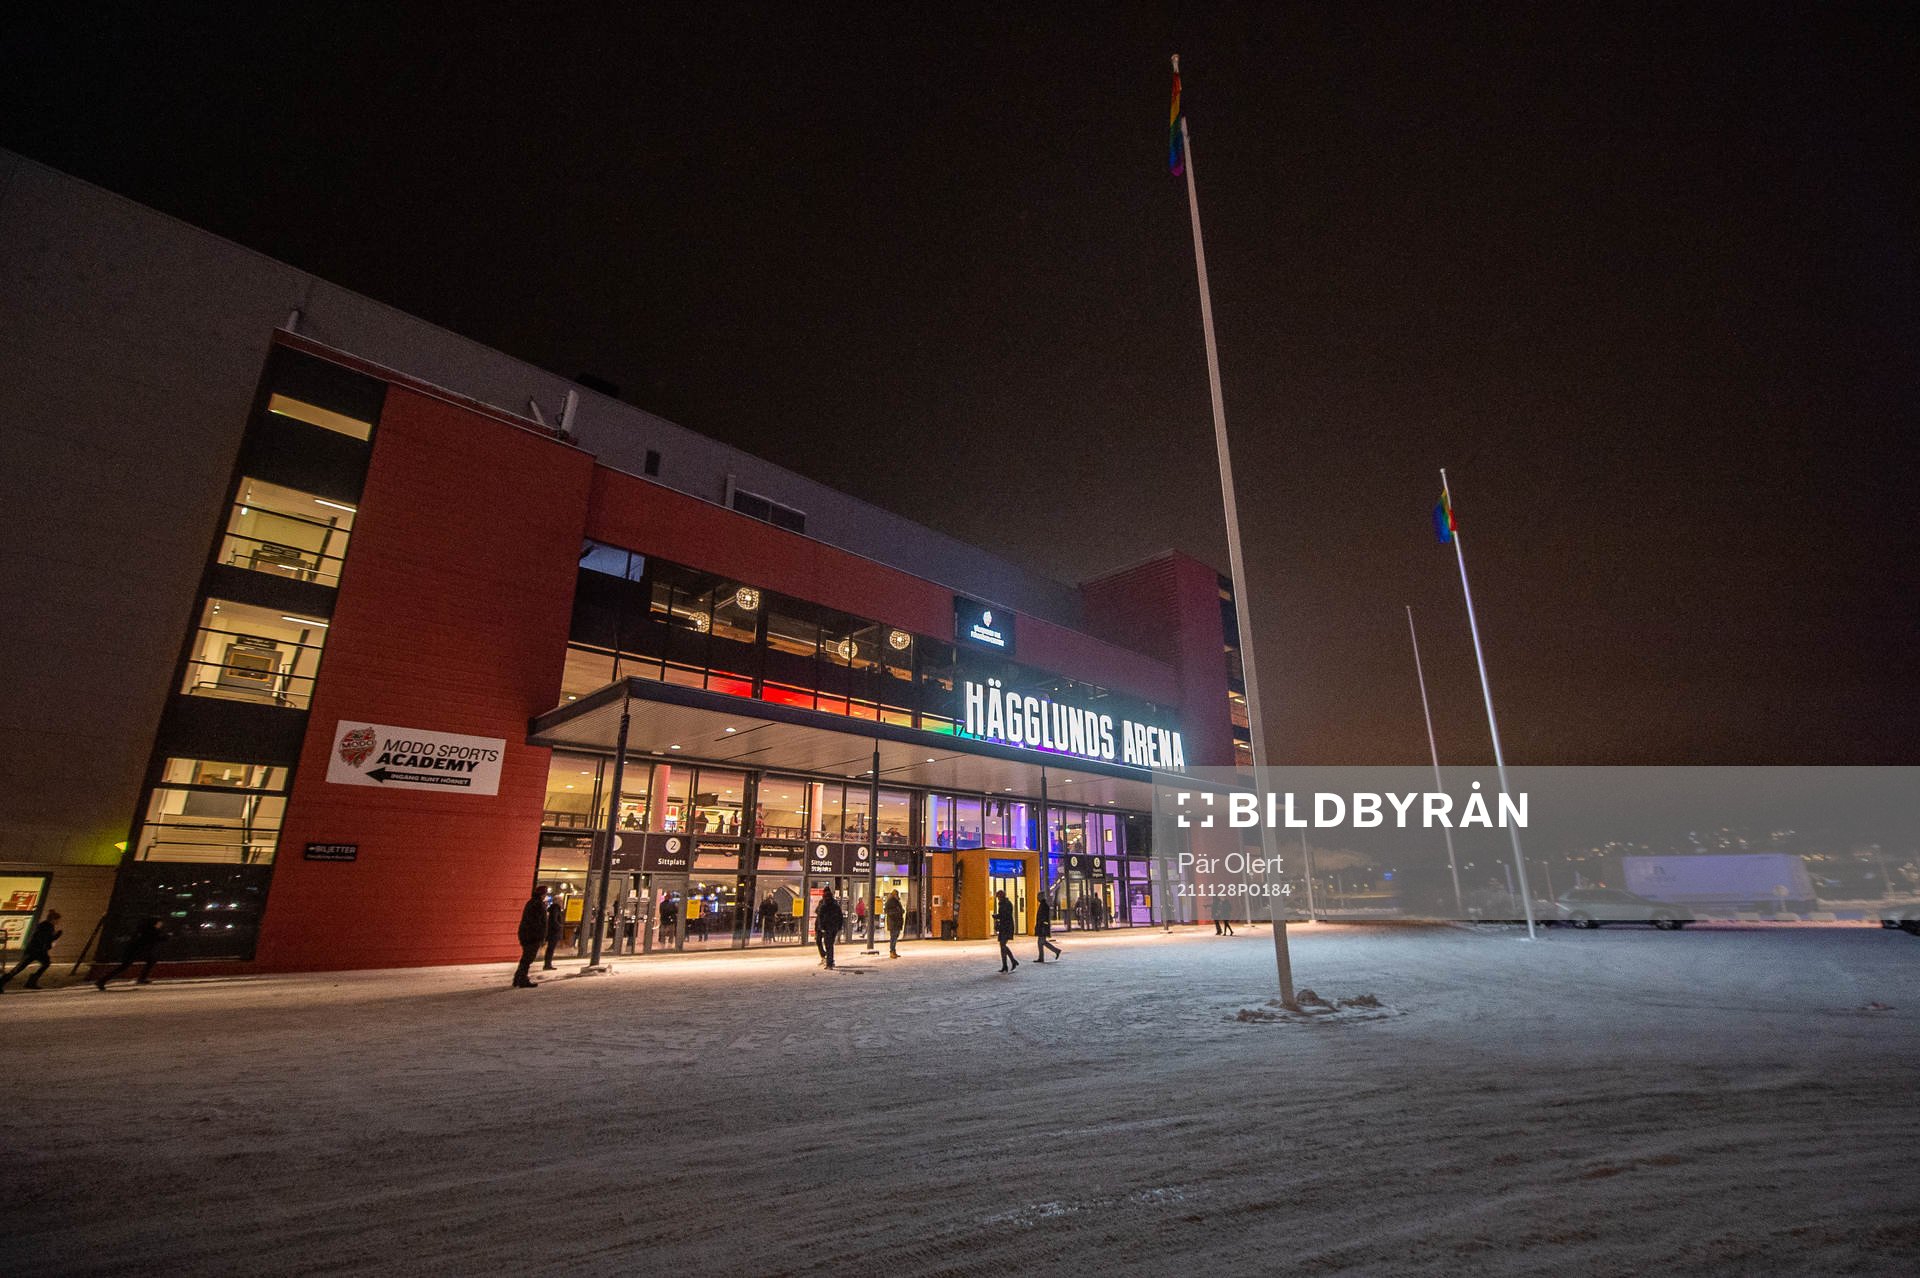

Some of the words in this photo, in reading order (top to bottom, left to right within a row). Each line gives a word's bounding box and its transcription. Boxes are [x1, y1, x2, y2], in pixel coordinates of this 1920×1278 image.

[965, 678, 1116, 760] HÄGGLUNDS
[1122, 720, 1186, 774] ARENA
[342, 739, 375, 749] MODO
[383, 739, 435, 756] MODO
[437, 744, 499, 762] SPORTS
[376, 752, 480, 773] ACADEMY
[420, 775, 440, 783] RUNT
[657, 858, 686, 866] Sittplats
